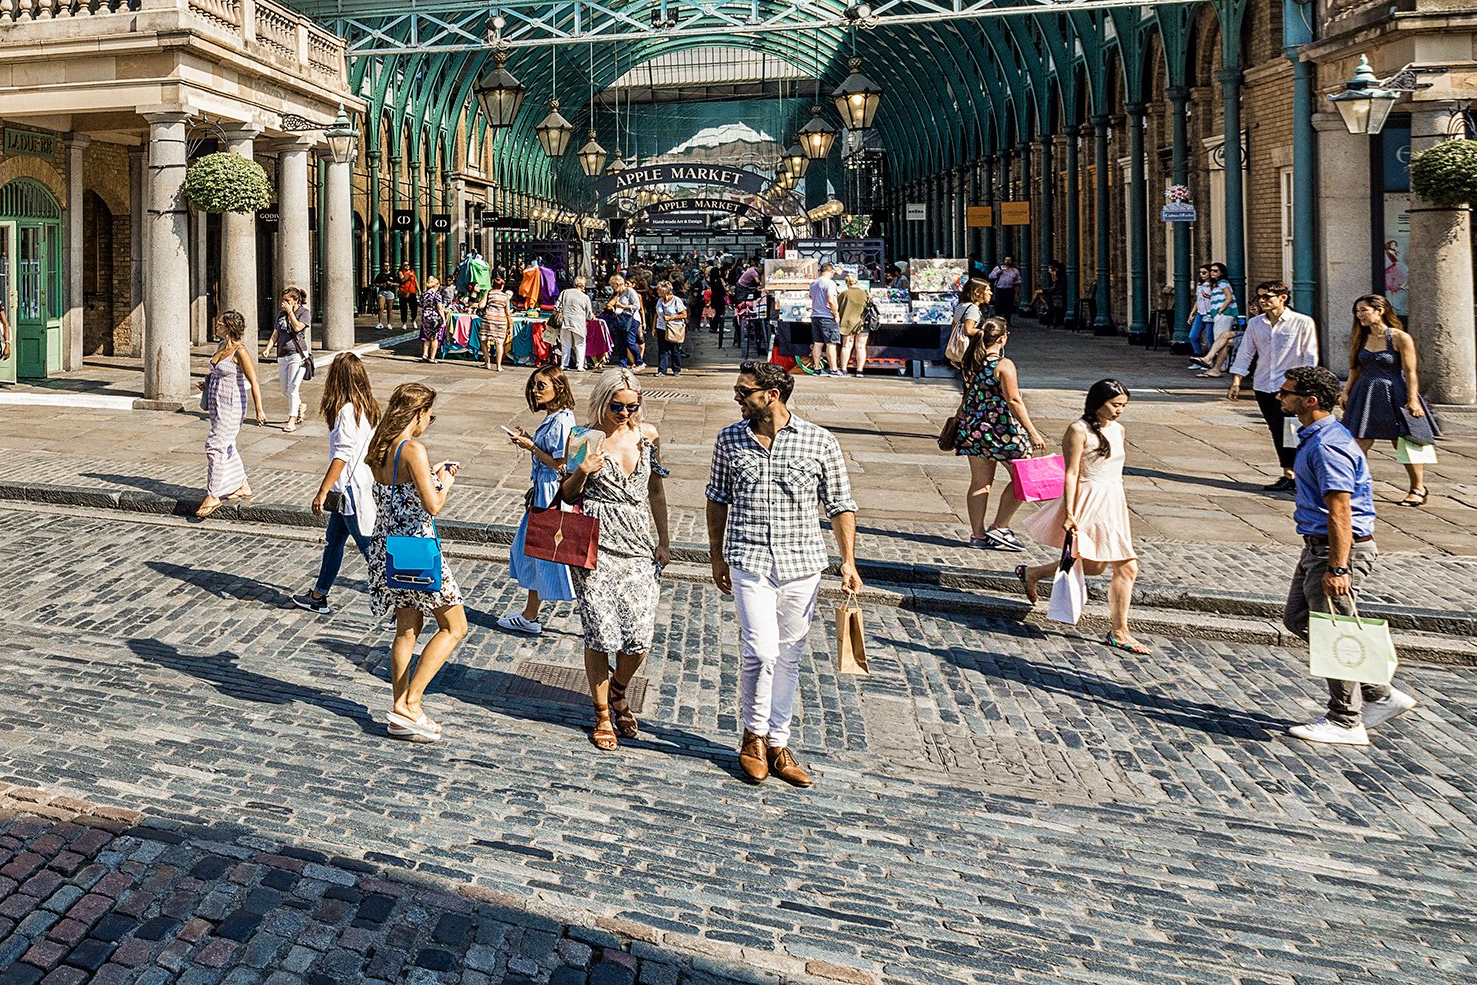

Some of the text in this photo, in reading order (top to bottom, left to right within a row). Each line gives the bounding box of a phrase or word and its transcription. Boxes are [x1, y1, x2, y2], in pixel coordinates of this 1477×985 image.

[616, 167, 743, 188] APPLE MARKET
[657, 200, 741, 212] APPLE MARKET
